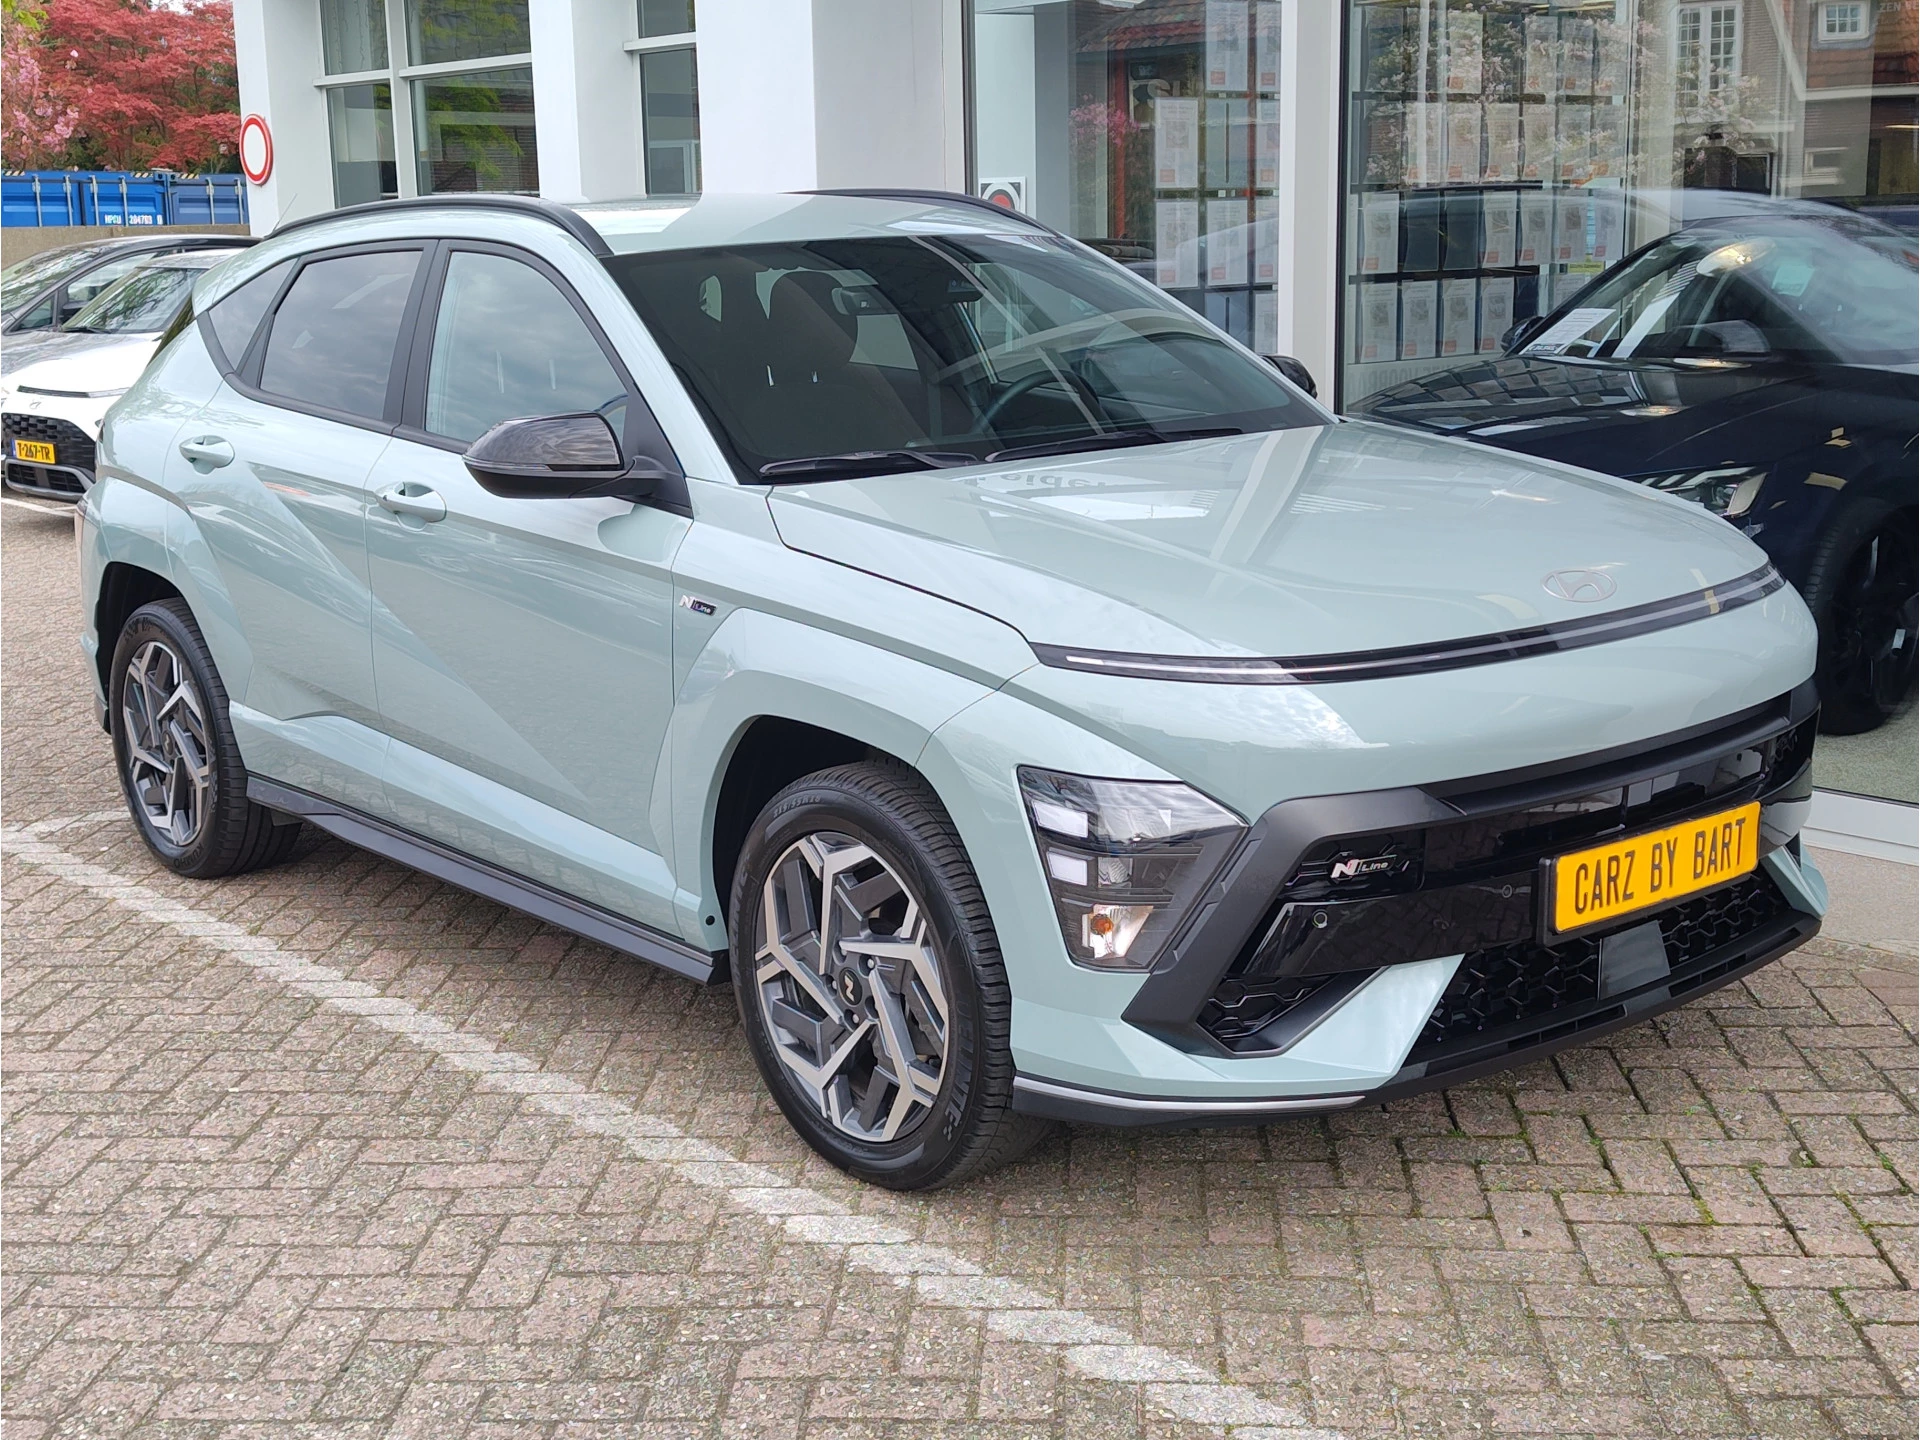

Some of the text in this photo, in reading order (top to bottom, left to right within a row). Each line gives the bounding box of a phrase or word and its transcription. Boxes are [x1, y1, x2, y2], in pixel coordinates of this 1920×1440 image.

[1575, 817, 1746, 914] CARZ BY BART
